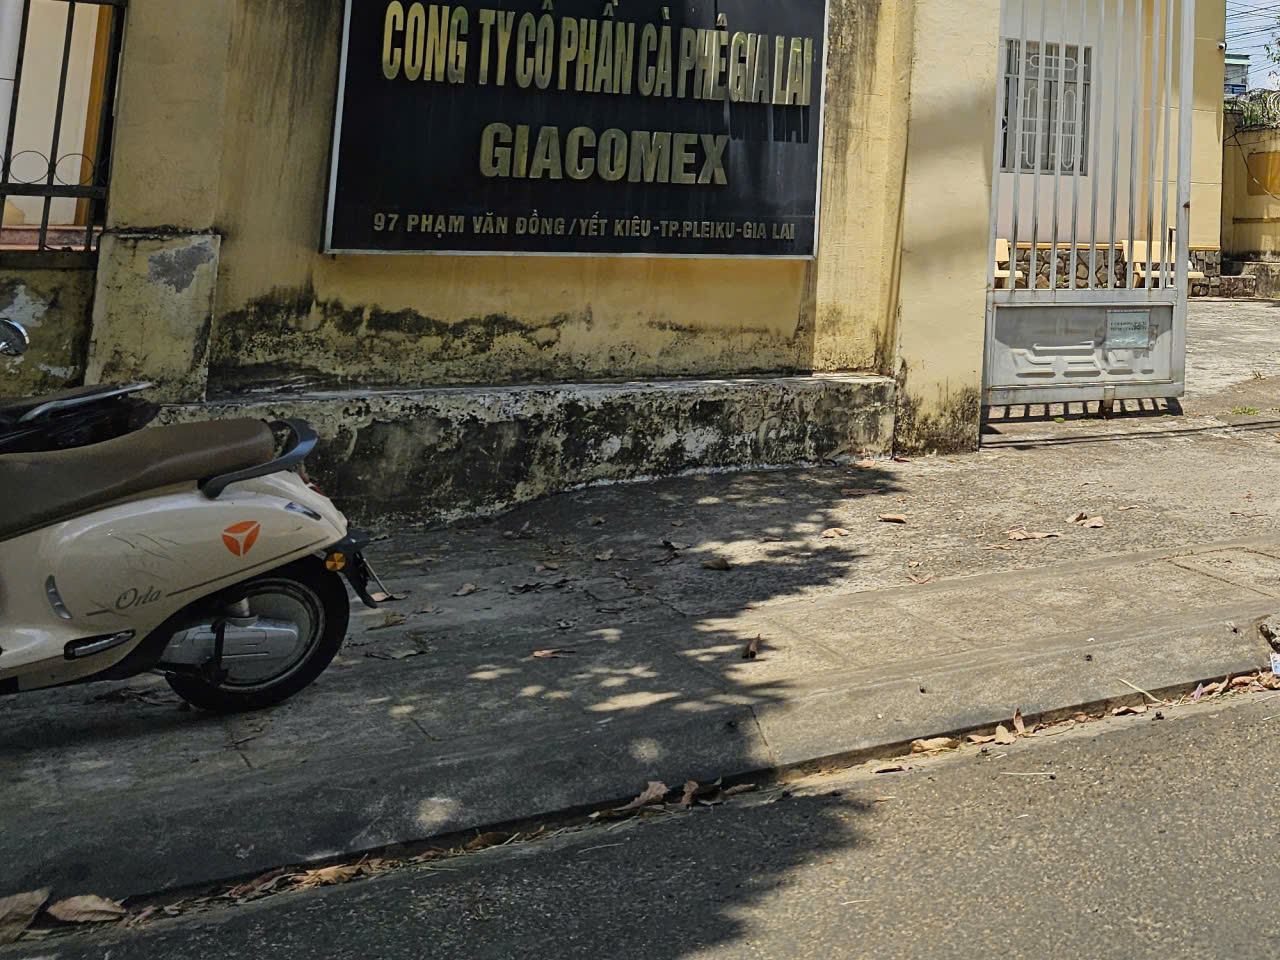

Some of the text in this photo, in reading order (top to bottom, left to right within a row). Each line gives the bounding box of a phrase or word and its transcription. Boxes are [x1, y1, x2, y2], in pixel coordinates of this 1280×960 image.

[479, 9, 516, 86] TY
[638, 6, 673, 97] CÀ
[677, 12, 729, 101] PHÊ
[729, 31, 769, 104] GIA
[772, 35, 813, 105] LAI
[479, 122, 730, 185] GIACOMEX
[374, 212, 399, 231] 97
[406, 214, 465, 238] PHẠM
[472, 211, 508, 234] VĂN
[772, 223, 795, 240] LAI
